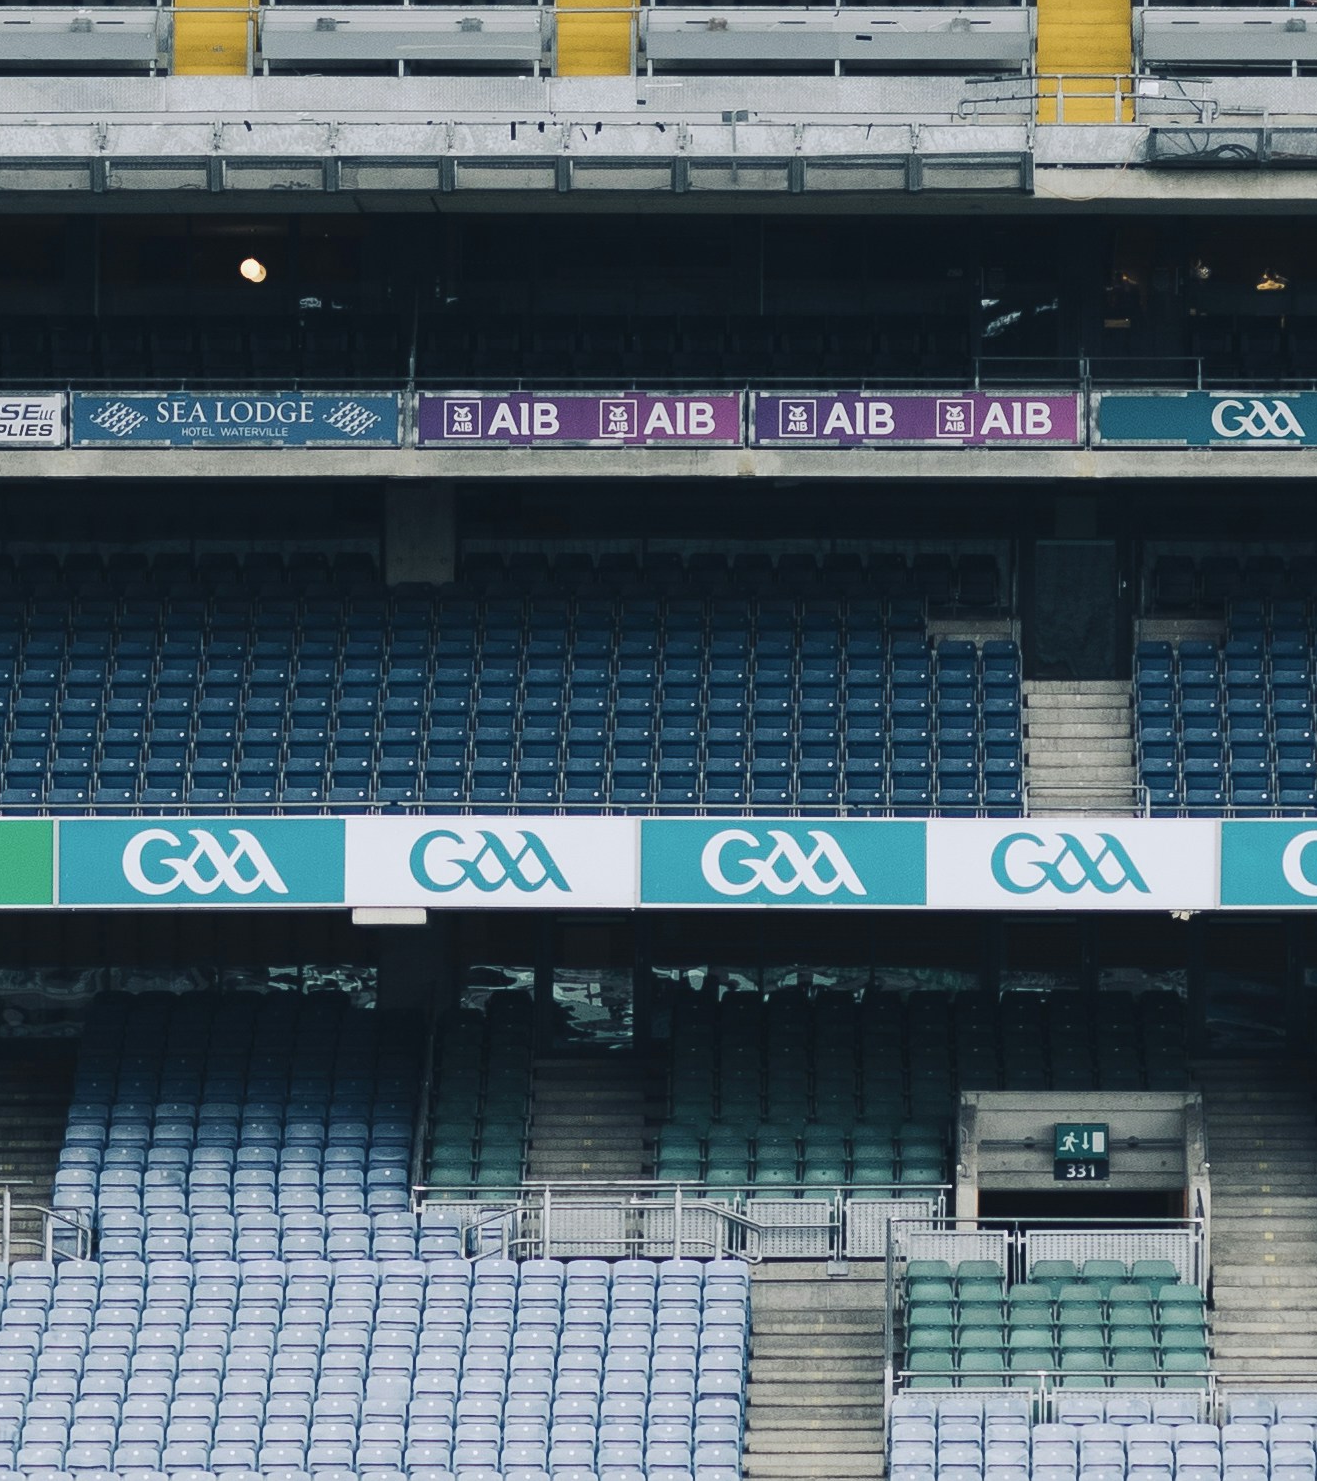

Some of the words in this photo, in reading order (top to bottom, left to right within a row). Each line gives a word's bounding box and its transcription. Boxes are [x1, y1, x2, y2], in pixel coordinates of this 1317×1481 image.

[156, 401, 207, 424] SEA
[214, 401, 314, 424] LODGE
[452, 421, 474, 432] AIB
[488, 402, 560, 435] AIB
[607, 421, 629, 432] AIB
[643, 402, 716, 435] AIB
[787, 421, 809, 432] AIB
[823, 402, 895, 435] AIB
[943, 421, 965, 432] AIB
[980, 402, 1052, 435] AIB
[1211, 399, 1306, 438] GAA
[182, 426, 215, 437] HOTEL
[220, 426, 289, 437] WATERVILLE
[121, 828, 290, 895] GAA
[408, 829, 573, 893] GAA
[700, 829, 868, 896] GAA
[990, 832, 1152, 894] GAA
[1066, 1163, 1096, 1178] 331
